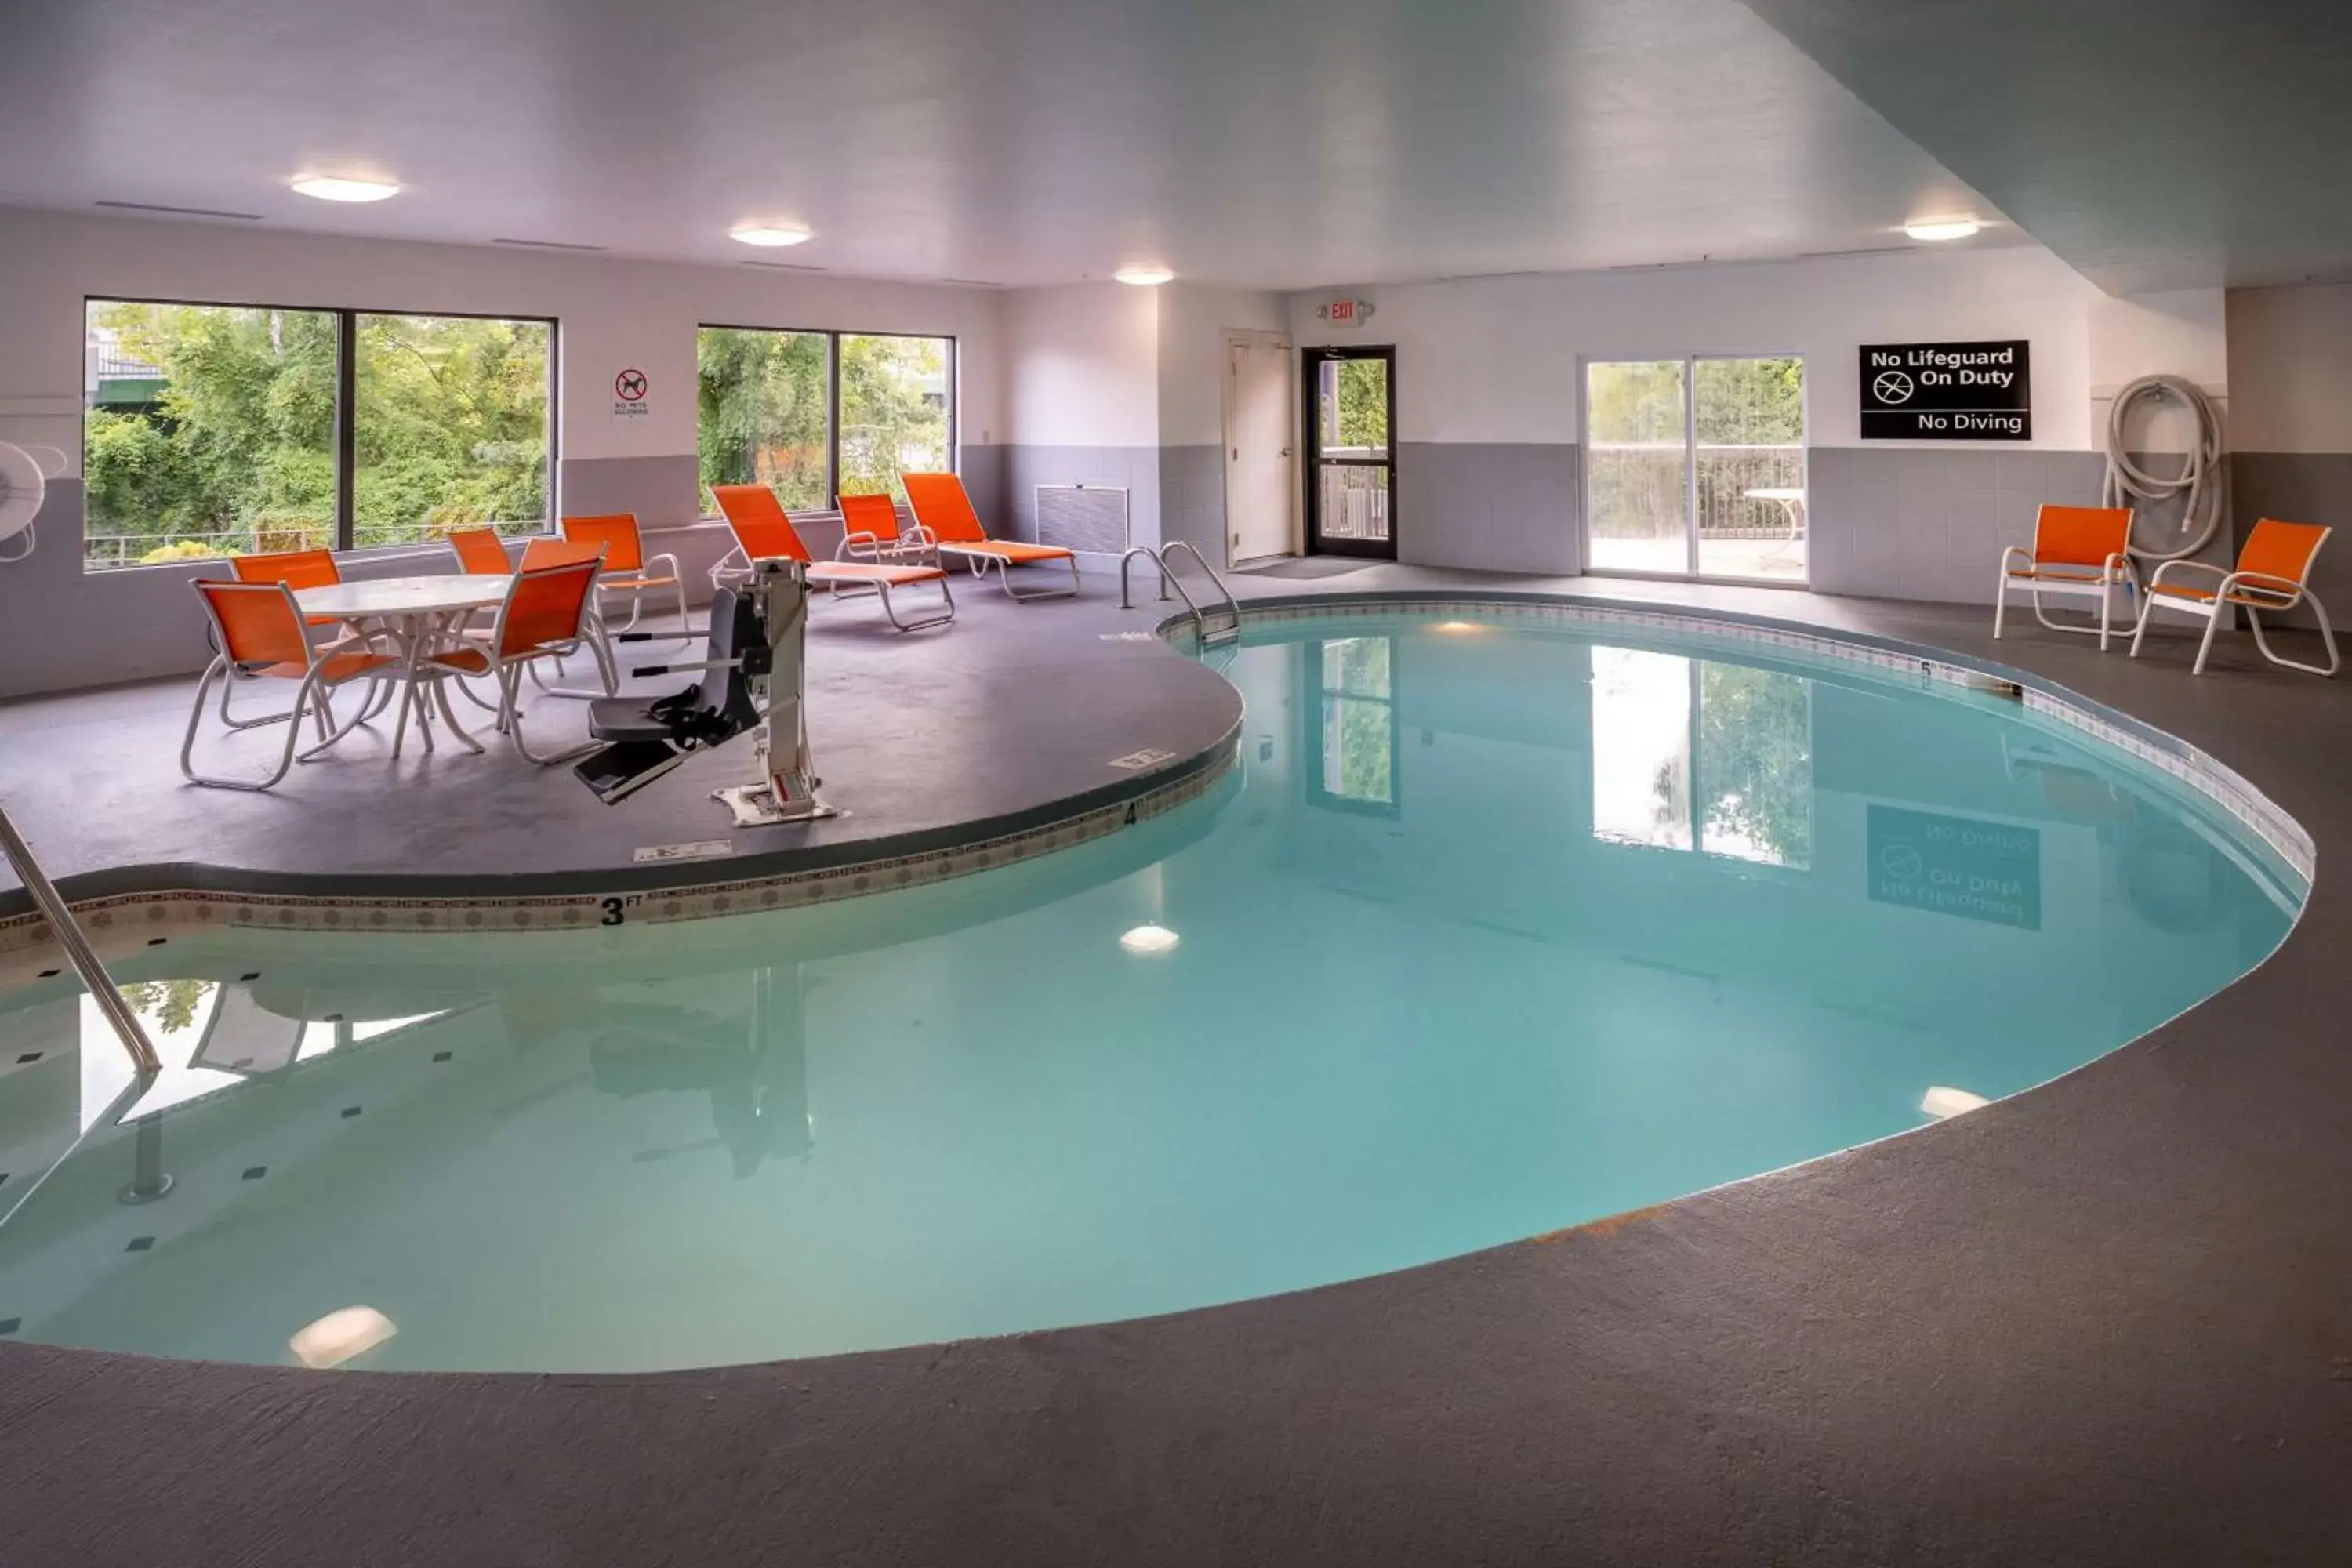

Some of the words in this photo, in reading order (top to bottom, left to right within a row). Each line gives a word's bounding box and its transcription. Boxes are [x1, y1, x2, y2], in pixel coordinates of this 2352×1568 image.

[1332, 303, 1353, 319] EXIT
[1871, 352, 1901, 367] No
[1908, 348, 2013, 369] Lifeguard
[1920, 370, 1952, 386] On
[1959, 370, 2014, 388] Duty
[1918, 414, 1948, 430] No
[1954, 413, 2023, 434] Diving
[601, 898, 625, 926] 3
